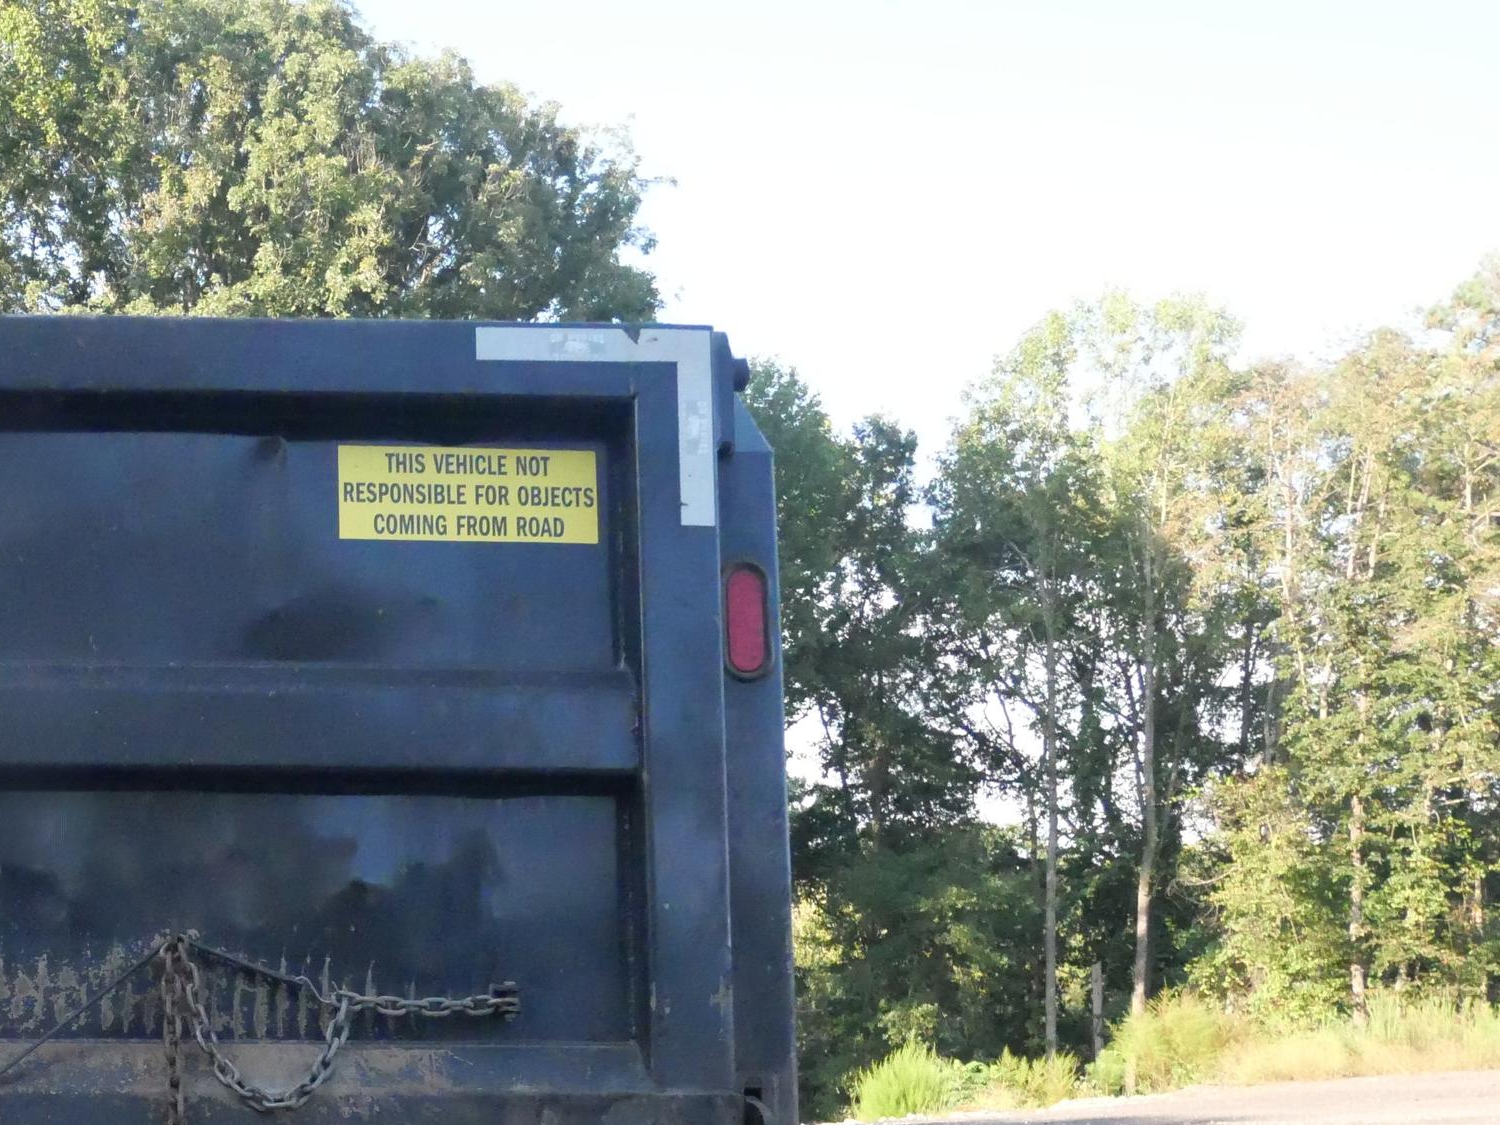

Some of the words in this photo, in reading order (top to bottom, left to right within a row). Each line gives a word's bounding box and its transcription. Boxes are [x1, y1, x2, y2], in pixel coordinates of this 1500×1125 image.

[385, 453, 425, 474] THIS
[433, 453, 507, 476] VEHICLE
[516, 456, 550, 477] NOT
[343, 482, 467, 505] RESPONSIBLE
[475, 484, 509, 506] FOR
[517, 486, 594, 508] OBJECTS
[374, 513, 447, 536] COMING
[456, 515, 507, 537] FROM
[516, 516, 565, 538] ROAD
